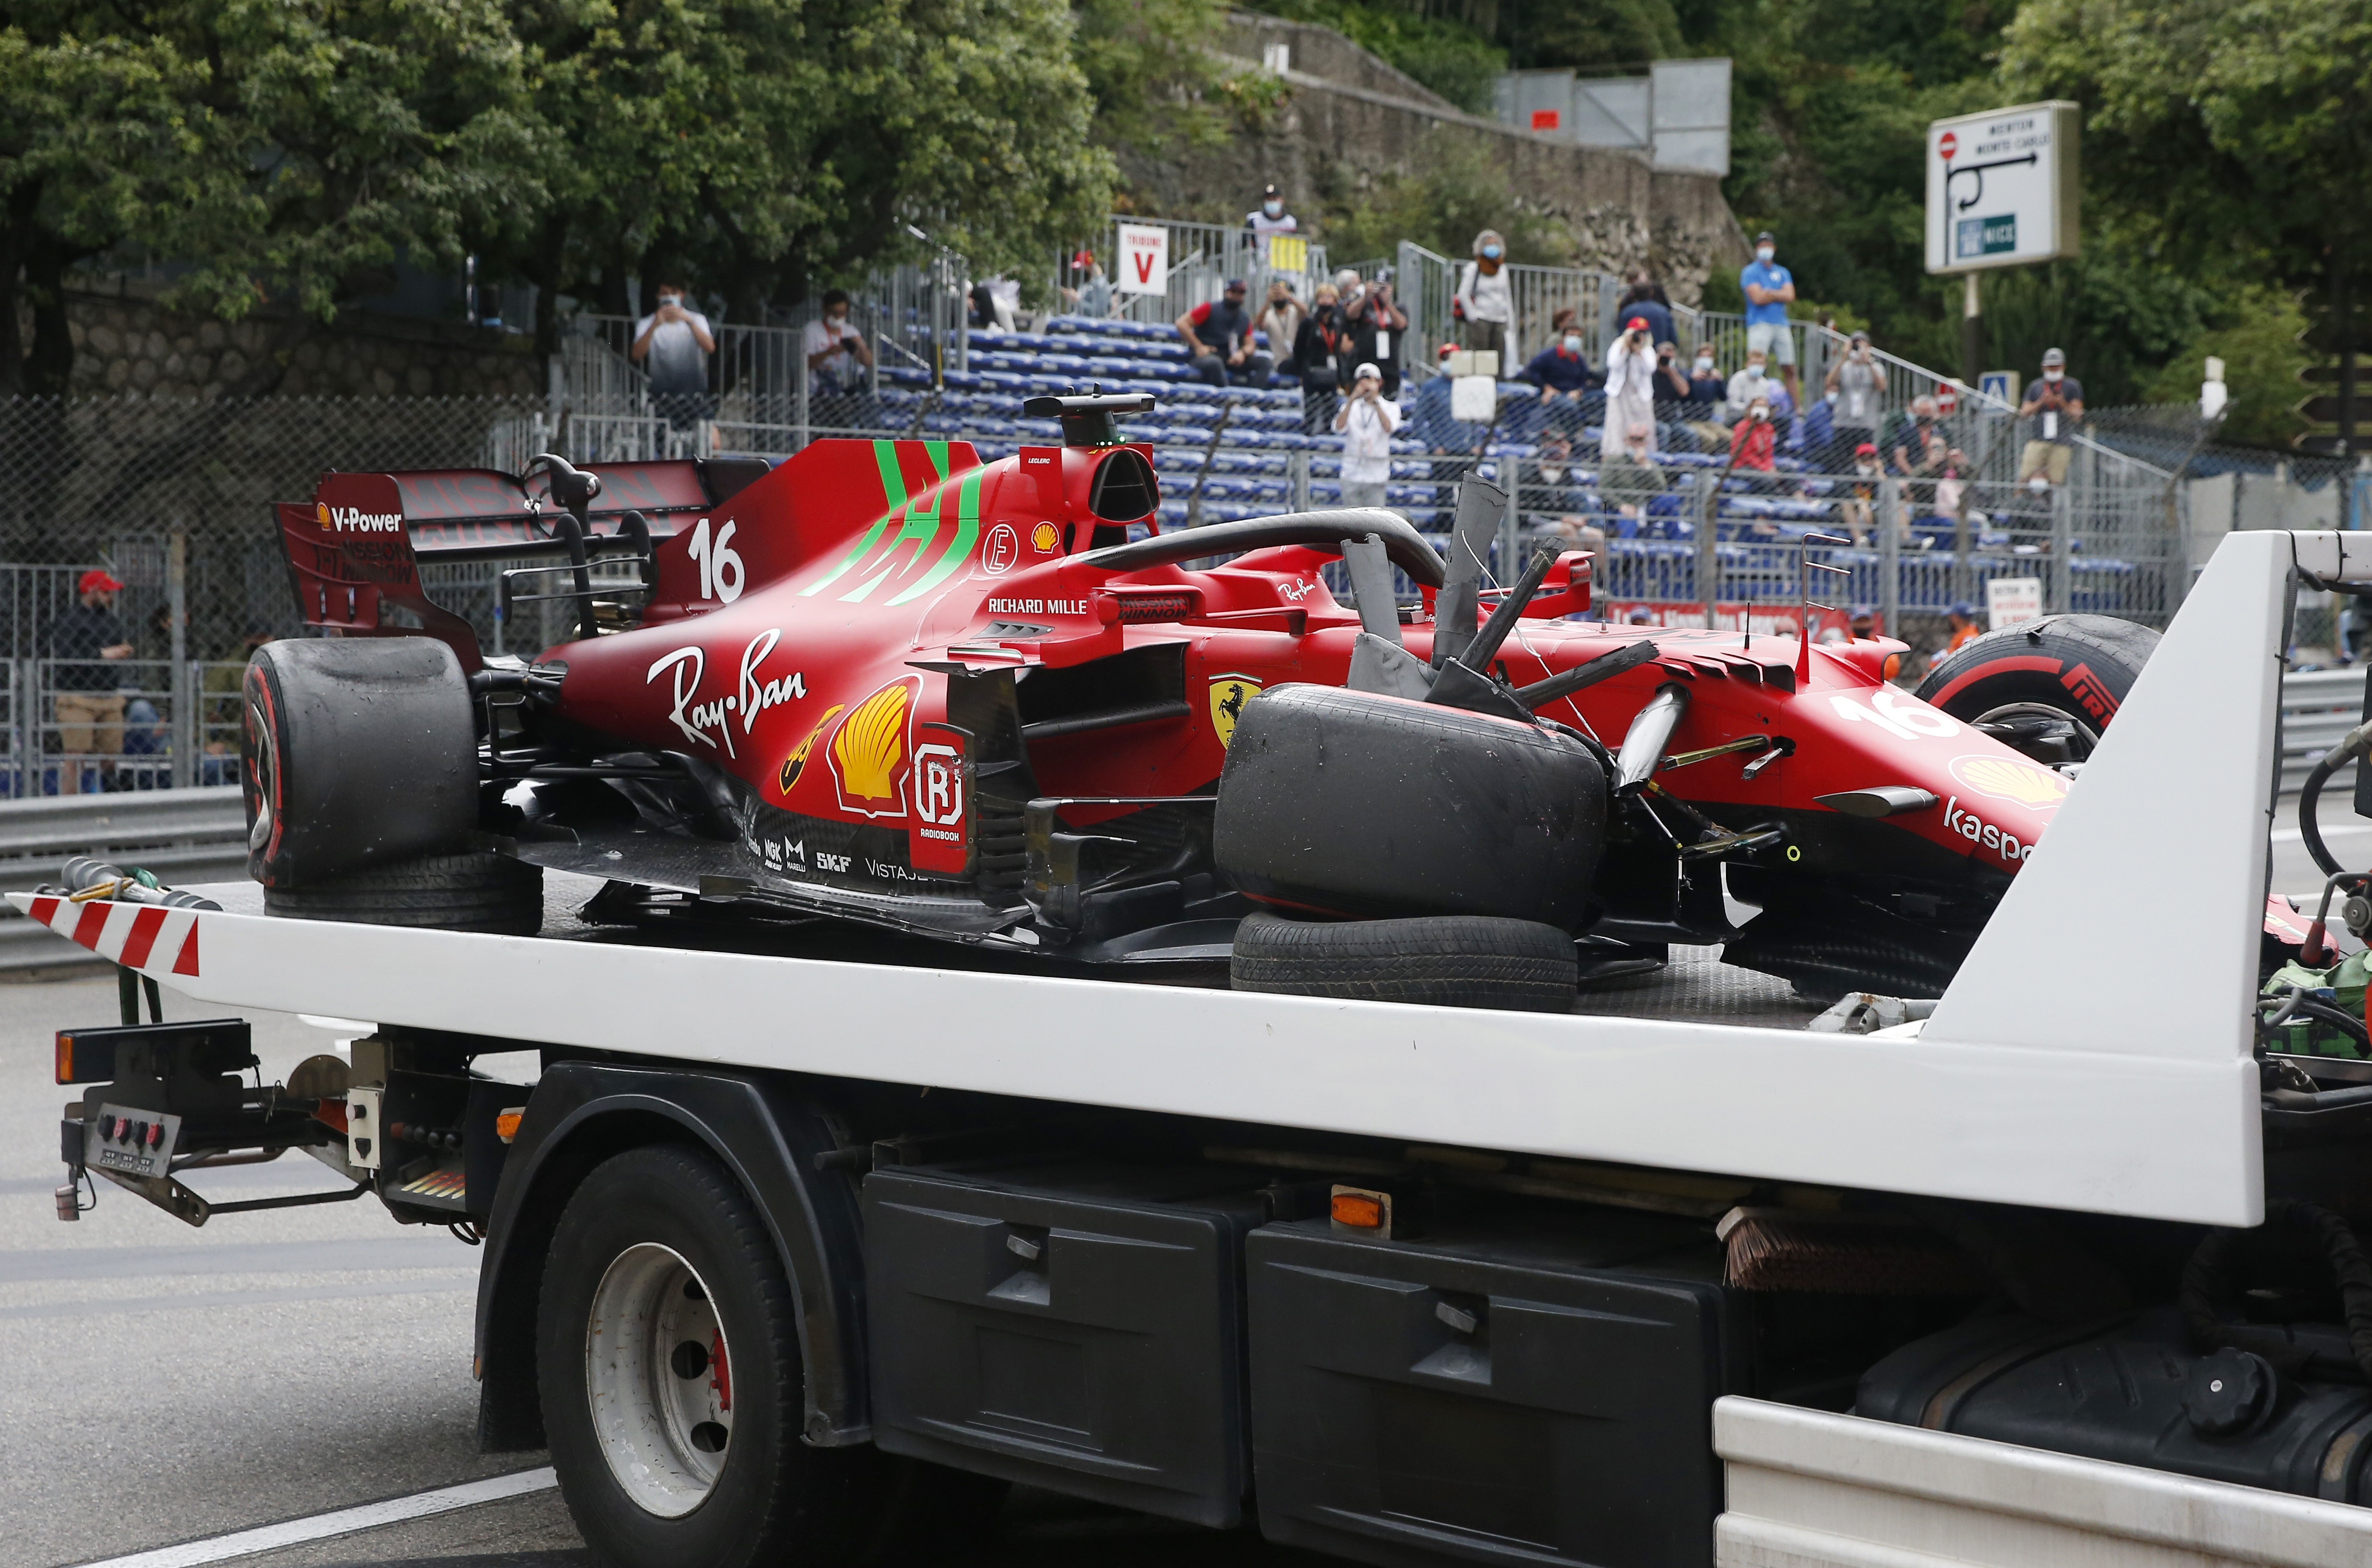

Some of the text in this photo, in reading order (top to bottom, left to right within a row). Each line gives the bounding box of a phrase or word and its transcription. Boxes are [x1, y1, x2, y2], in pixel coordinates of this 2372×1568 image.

[1134, 252, 1154, 284] V
[331, 507, 402, 532] V-Power
[688, 517, 745, 604] 16
[988, 598, 1087, 614] RICHARD MILLE
[1828, 690, 1960, 740] 16
[920, 828, 959, 842] RADIOBOOK
[765, 838, 782, 863] NGK
[817, 852, 852, 872] SKF
[787, 861, 806, 873] MARELLI
